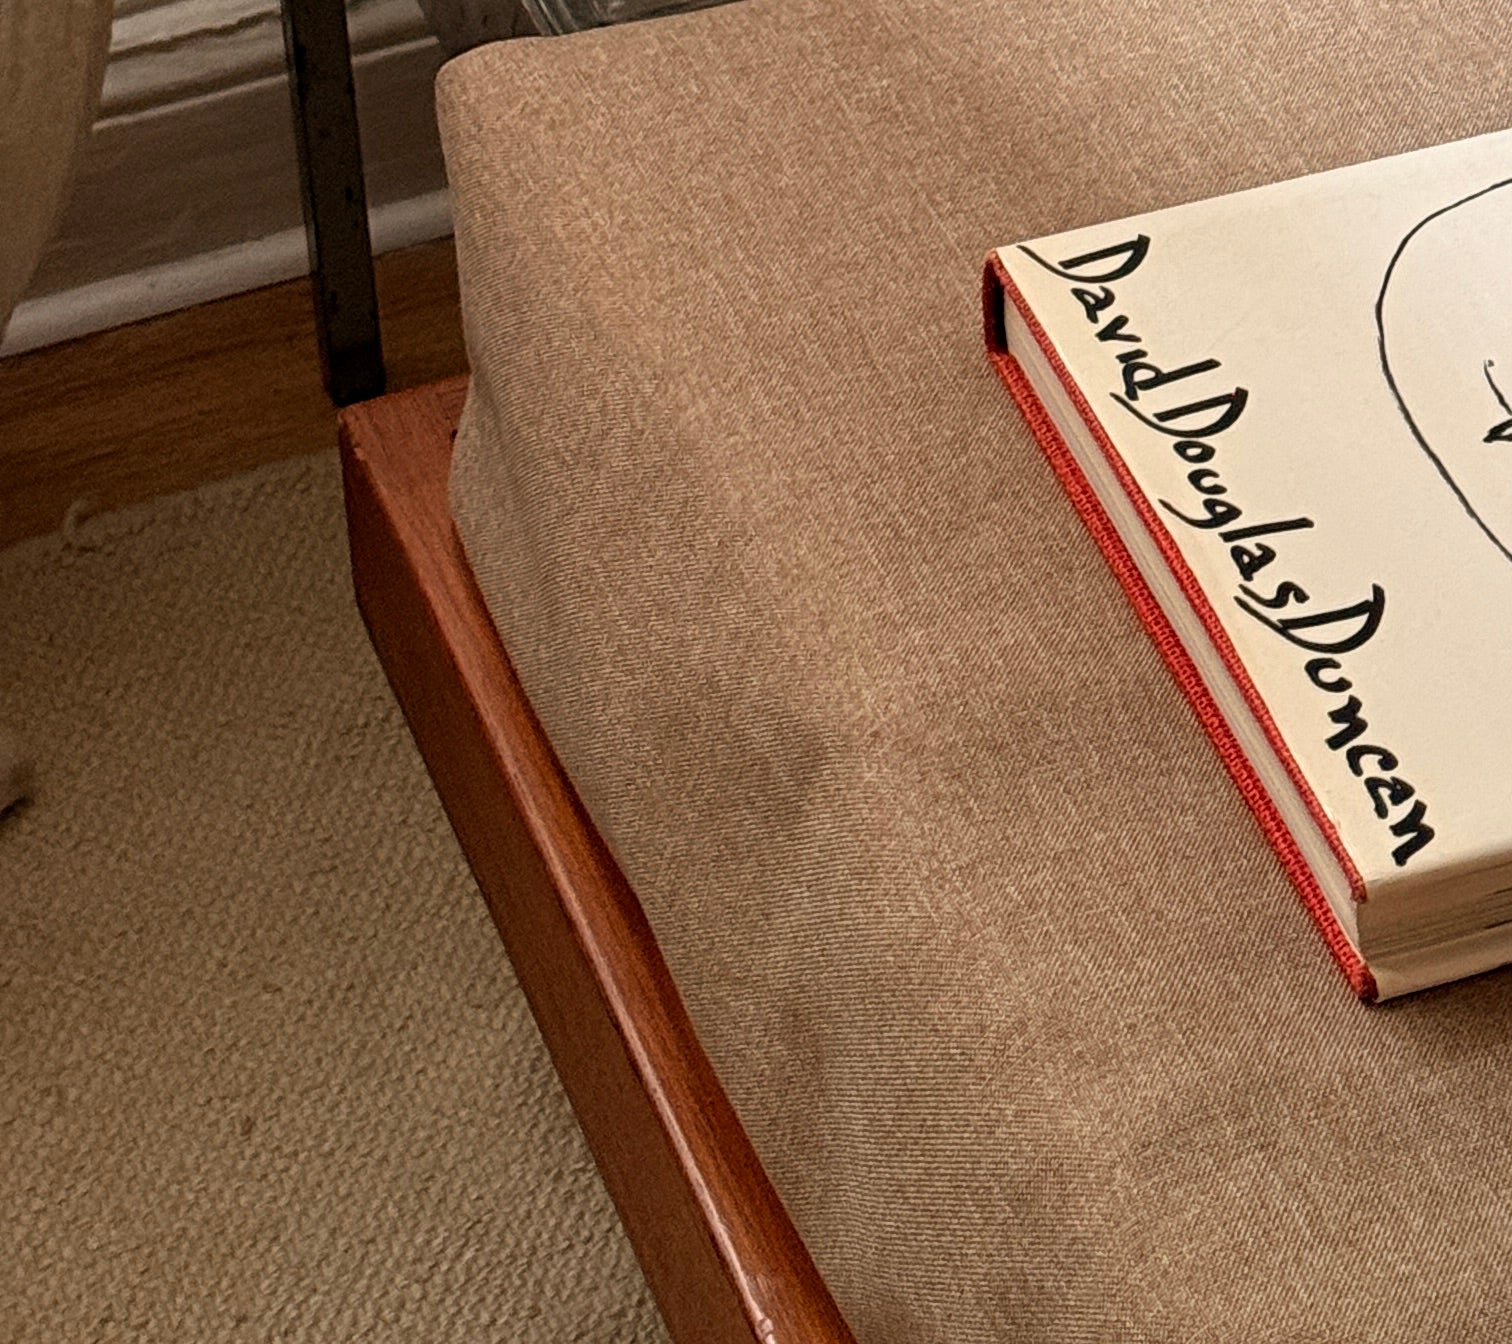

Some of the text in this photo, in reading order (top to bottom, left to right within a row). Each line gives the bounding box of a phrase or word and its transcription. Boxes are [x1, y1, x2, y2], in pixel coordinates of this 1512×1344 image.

[1017, 234, 1436, 866] David Douglas Duncan
